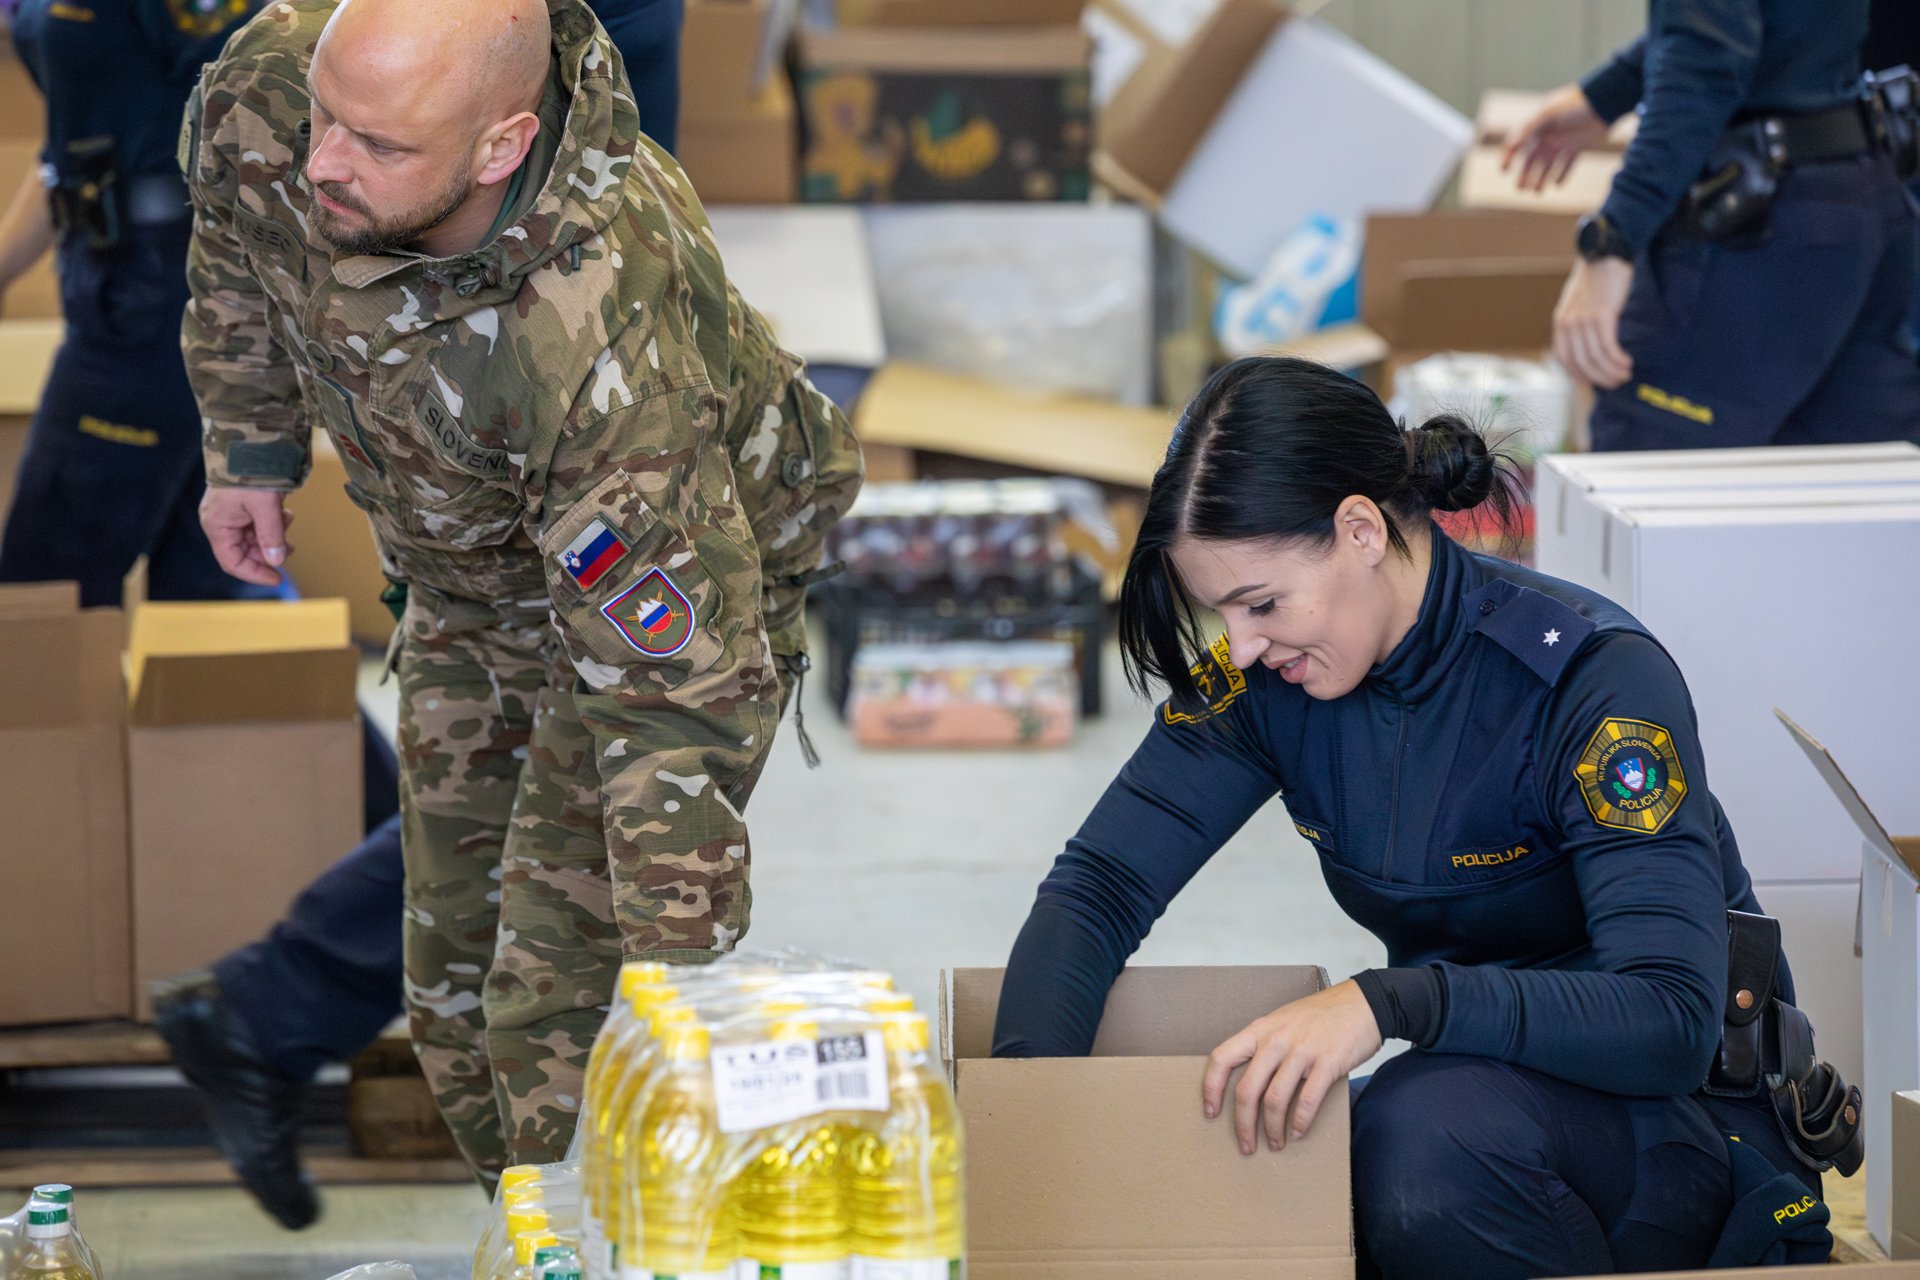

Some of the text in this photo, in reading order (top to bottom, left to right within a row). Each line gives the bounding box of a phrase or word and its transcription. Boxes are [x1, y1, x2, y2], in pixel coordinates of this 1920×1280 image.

[1620, 739, 1662, 761] SLOVENIJA
[1619, 787, 1663, 810] POLICIJA
[1452, 846, 1529, 868] POLICIJA
